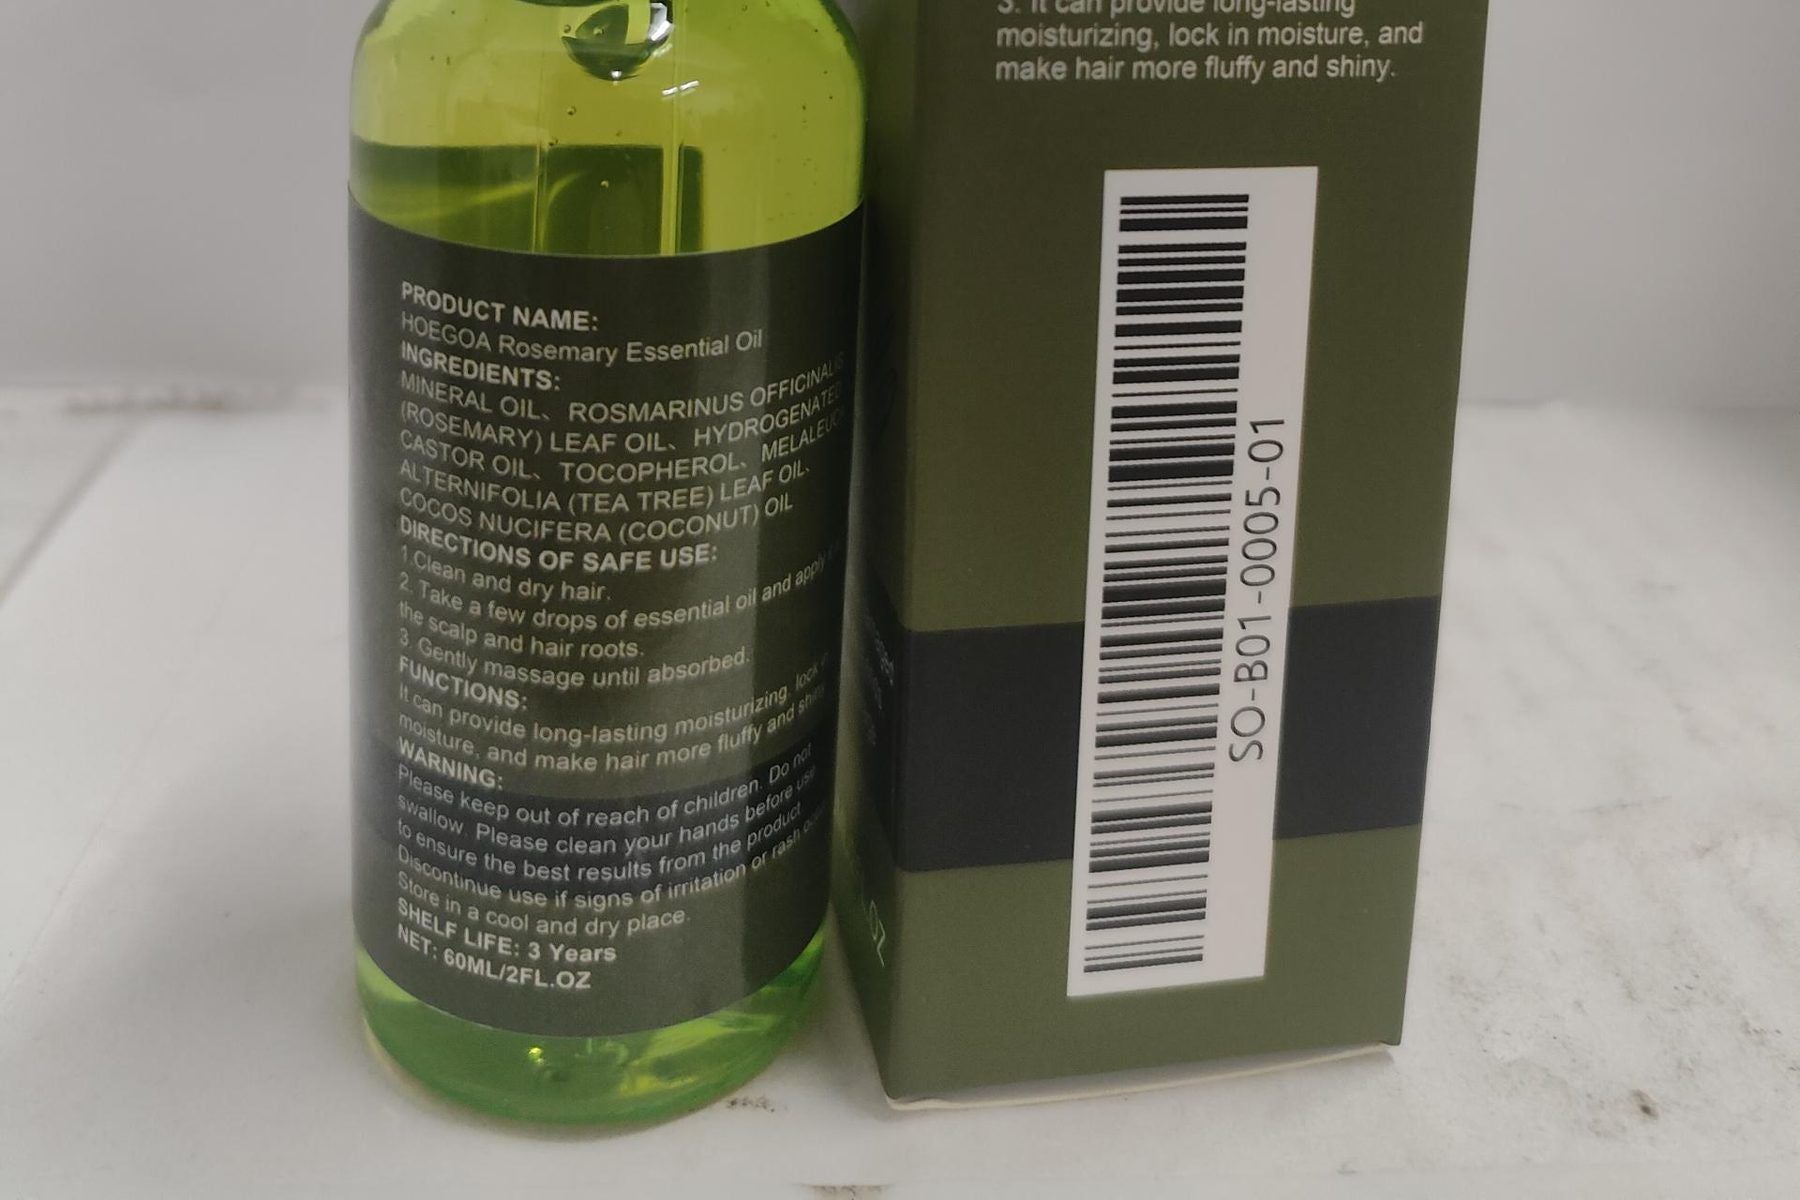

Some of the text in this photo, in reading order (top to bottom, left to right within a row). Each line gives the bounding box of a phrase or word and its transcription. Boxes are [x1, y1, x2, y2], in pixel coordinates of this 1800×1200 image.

[996, 22, 1423, 52] moisturizing, lock moisture, and
[996, 55, 1396, 84] make hair more fluffy and shiny.
[401, 281, 598, 331] PRODUCT NAME:
[401, 311, 763, 367] HOEGOA Rosemary Essential Oil
[401, 340, 560, 391] INGREDIENTS:
[401, 371, 744, 422] MINERAL ROSMARINUS
[400, 430, 485, 471] CASTOR
[401, 404, 616, 454] (ROSEMARY) LEAF
[400, 459, 774, 516] ALTERNIFOLIA (TEA TREE) LEAF
[400, 487, 793, 544] COCOS NUCIFERA (COCONUT) OIL
[401, 516, 717, 573] DIRECTIONS SAFE USE:
[419, 580, 757, 634] Take few drops essential oil
[518, 578, 552, 602] dry
[561, 581, 611, 602] hair.
[1228, 418, 1285, 762] SO-B01-0005-01
[428, 613, 644, 658] scalp hair roots.
[400, 658, 528, 711] FUNCTIONS:
[418, 637, 750, 691] Gently massage until absorbed.
[450, 704, 667, 748] provide long-lasting
[534, 721, 763, 773] make hair more fluffy
[399, 737, 503, 790] WARNING:
[399, 765, 763, 826] Please keep reach children.
[476, 823, 548, 854] Please
[555, 829, 616, 854] clean
[624, 832, 672, 856] your
[679, 814, 739, 844] hands
[745, 784, 792, 820] before
[415, 829, 478, 864] ensure
[523, 856, 570, 881] best
[578, 859, 652, 882] results
[659, 849, 705, 872] from
[747, 803, 802, 852] product
[398, 847, 745, 911] Discontinue signs irritation
[398, 871, 689, 938] Store cool dry place.
[398, 898, 617, 962] SHELF LIFE: Years
[398, 924, 591, 990] NET: 60ML/2FL.OZ
